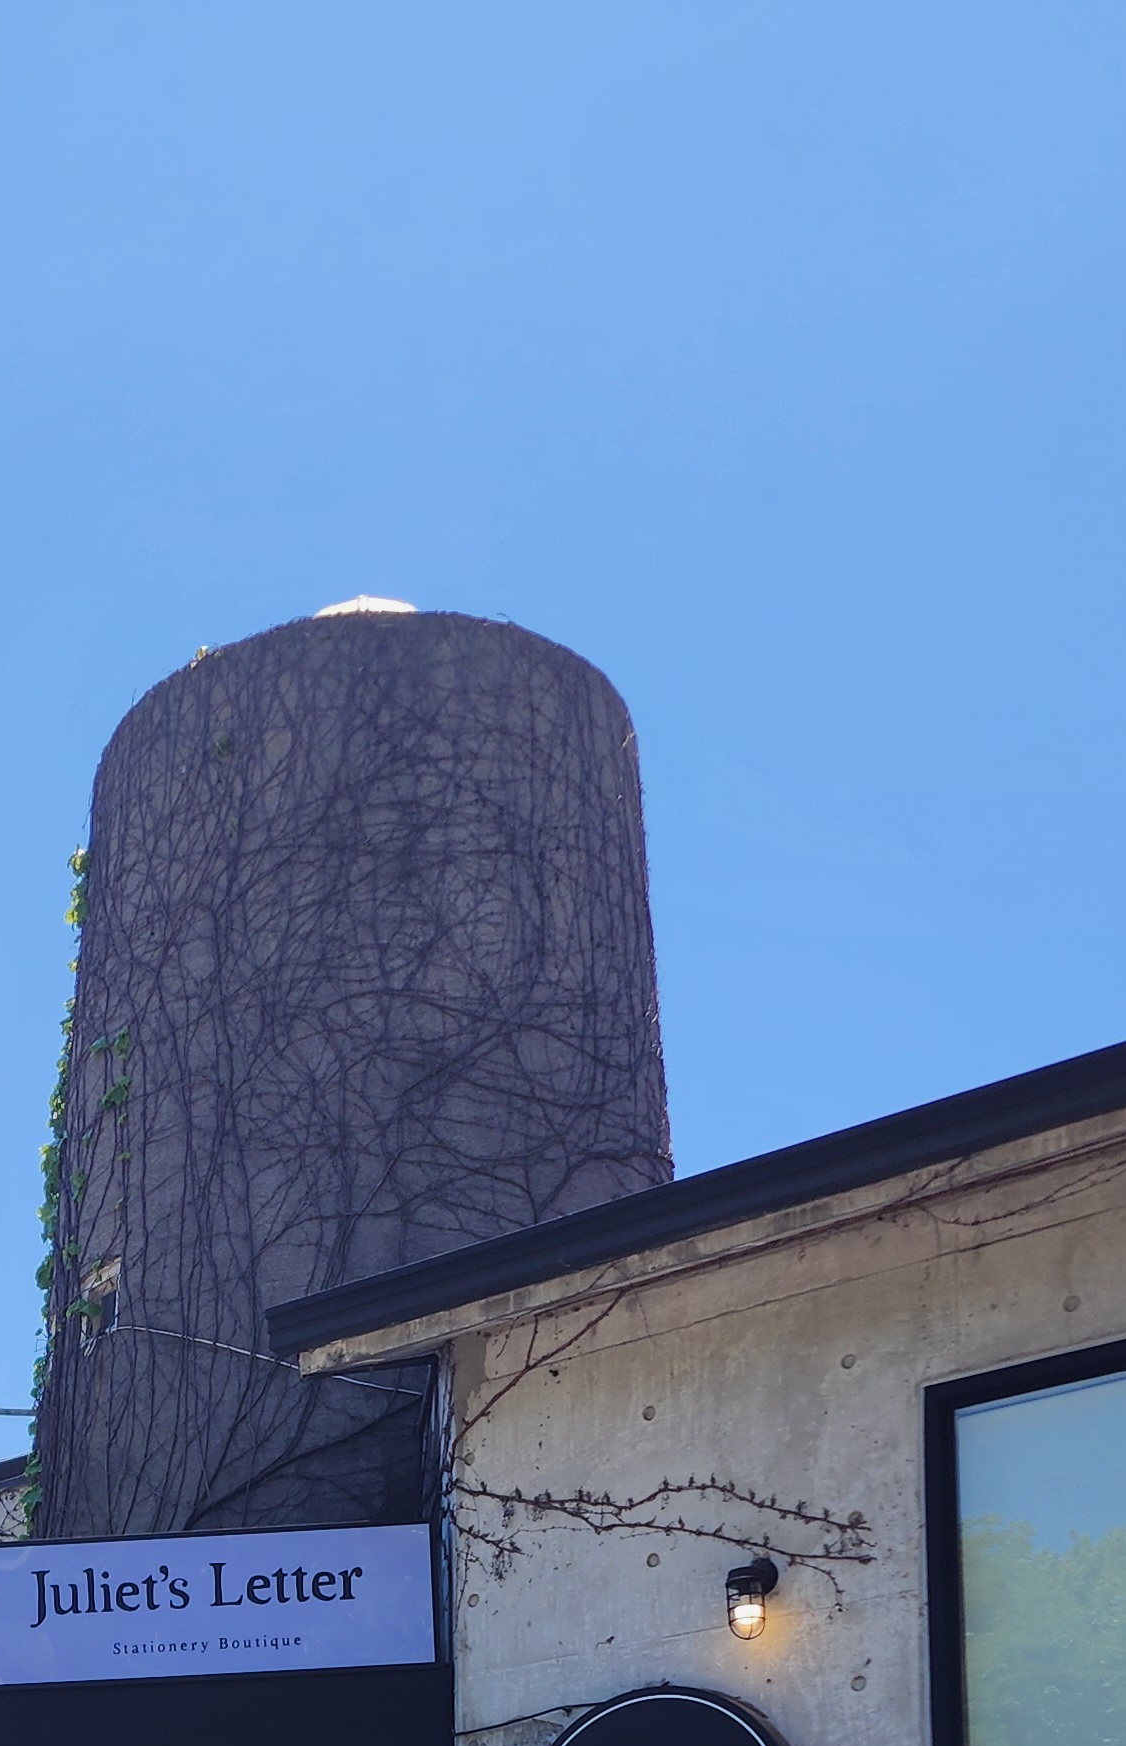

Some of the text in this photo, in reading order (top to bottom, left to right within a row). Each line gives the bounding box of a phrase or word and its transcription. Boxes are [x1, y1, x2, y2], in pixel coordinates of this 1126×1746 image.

[29, 1562, 364, 1629] Juliet’s Letter
[112, 1633, 303, 1656] Stationery Boutique
